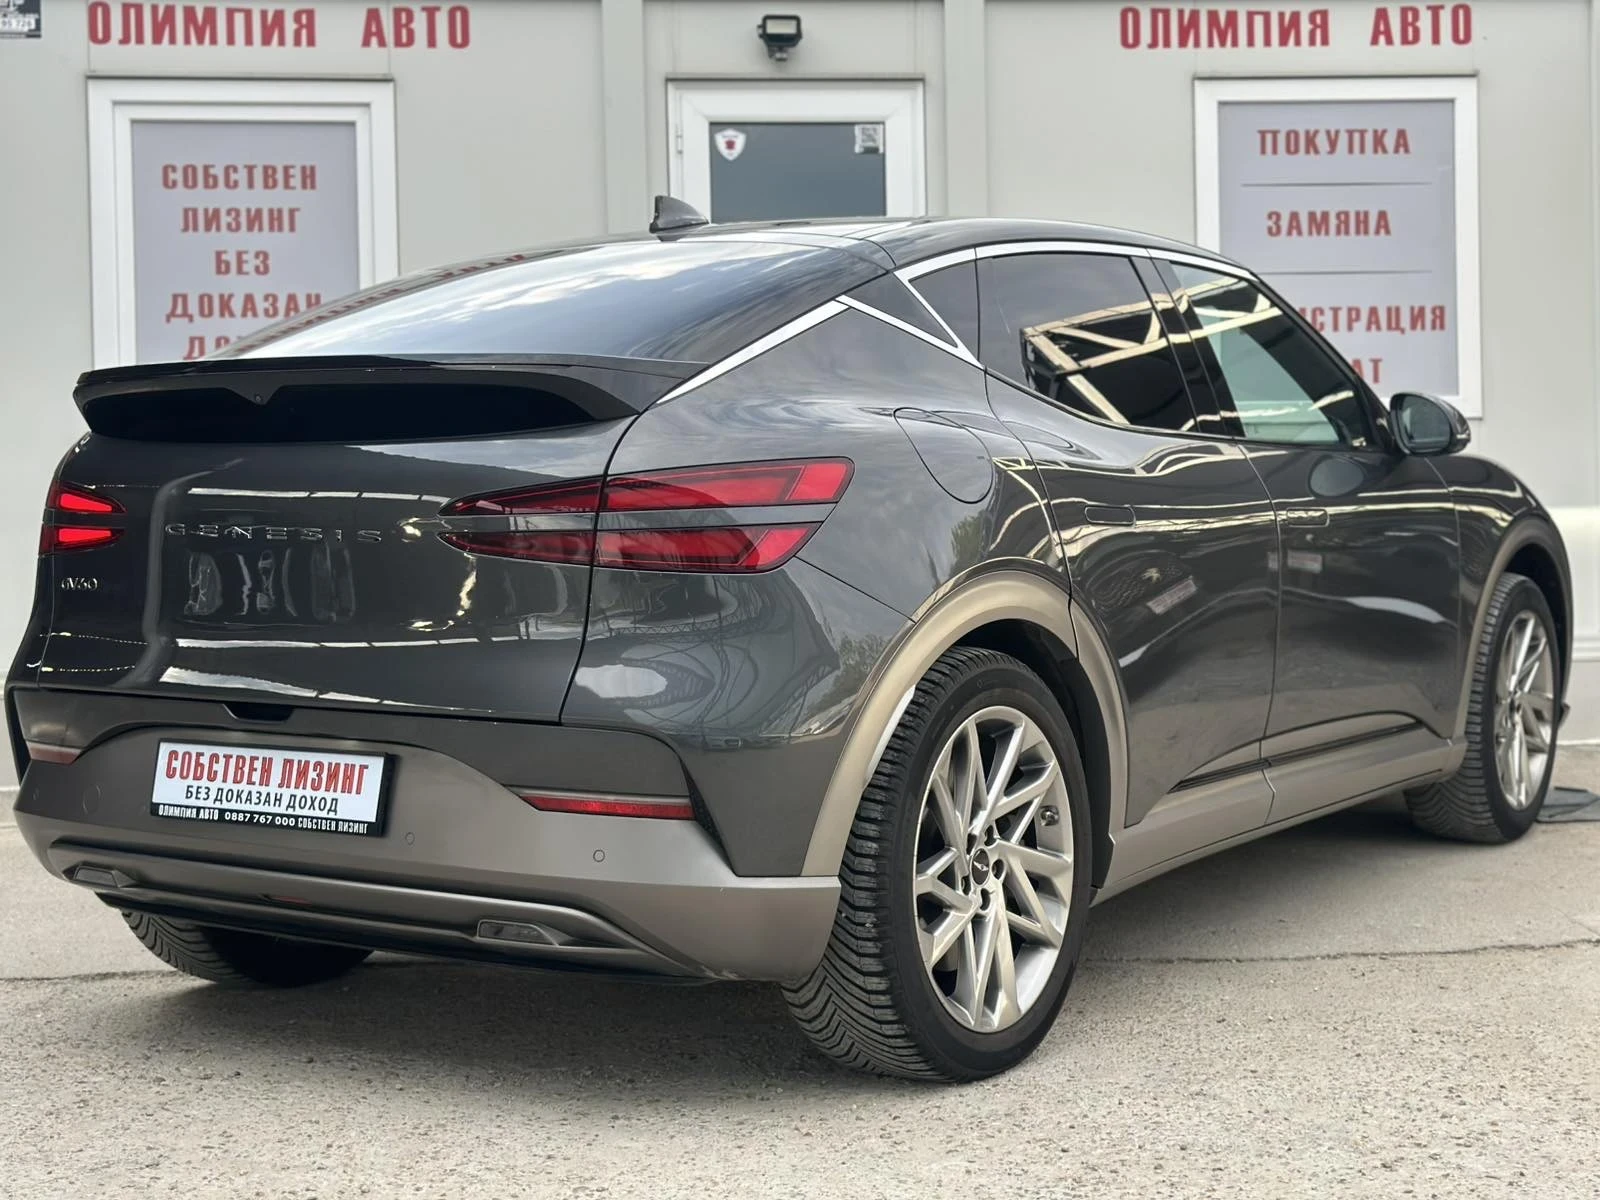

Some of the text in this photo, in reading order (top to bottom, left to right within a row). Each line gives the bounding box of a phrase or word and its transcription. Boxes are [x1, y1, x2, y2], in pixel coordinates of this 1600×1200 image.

[87, 1, 471, 50] ОЛИМПИЯ АВТО
[1119, 3, 1473, 51] ОЛИМПИЯ АВТО
[1257, 129, 1411, 156] ПОКУПКА
[162, 164, 317, 190] СОБСТВЕН
[181, 207, 301, 233] ЛИЗИНГ
[1266, 210, 1392, 238] ЗАМЯНА
[215, 250, 270, 276] БЕЗ
[165, 293, 322, 323] ДОКАЗАН
[1299, 305, 1446, 334] СТРАЦИЯ
[165, 523, 382, 542] GENESIS
[166, 750, 369, 795] СОБСТВЕН ЛИЗИНГ
[185, 785, 339, 816] БЕЗ ДОКАЗАН ДОХОД
[158, 805, 369, 834] ОЛИМПИЯ АВТО 0887 767 000 СОБСТВЕН ЛИЗИНГ
